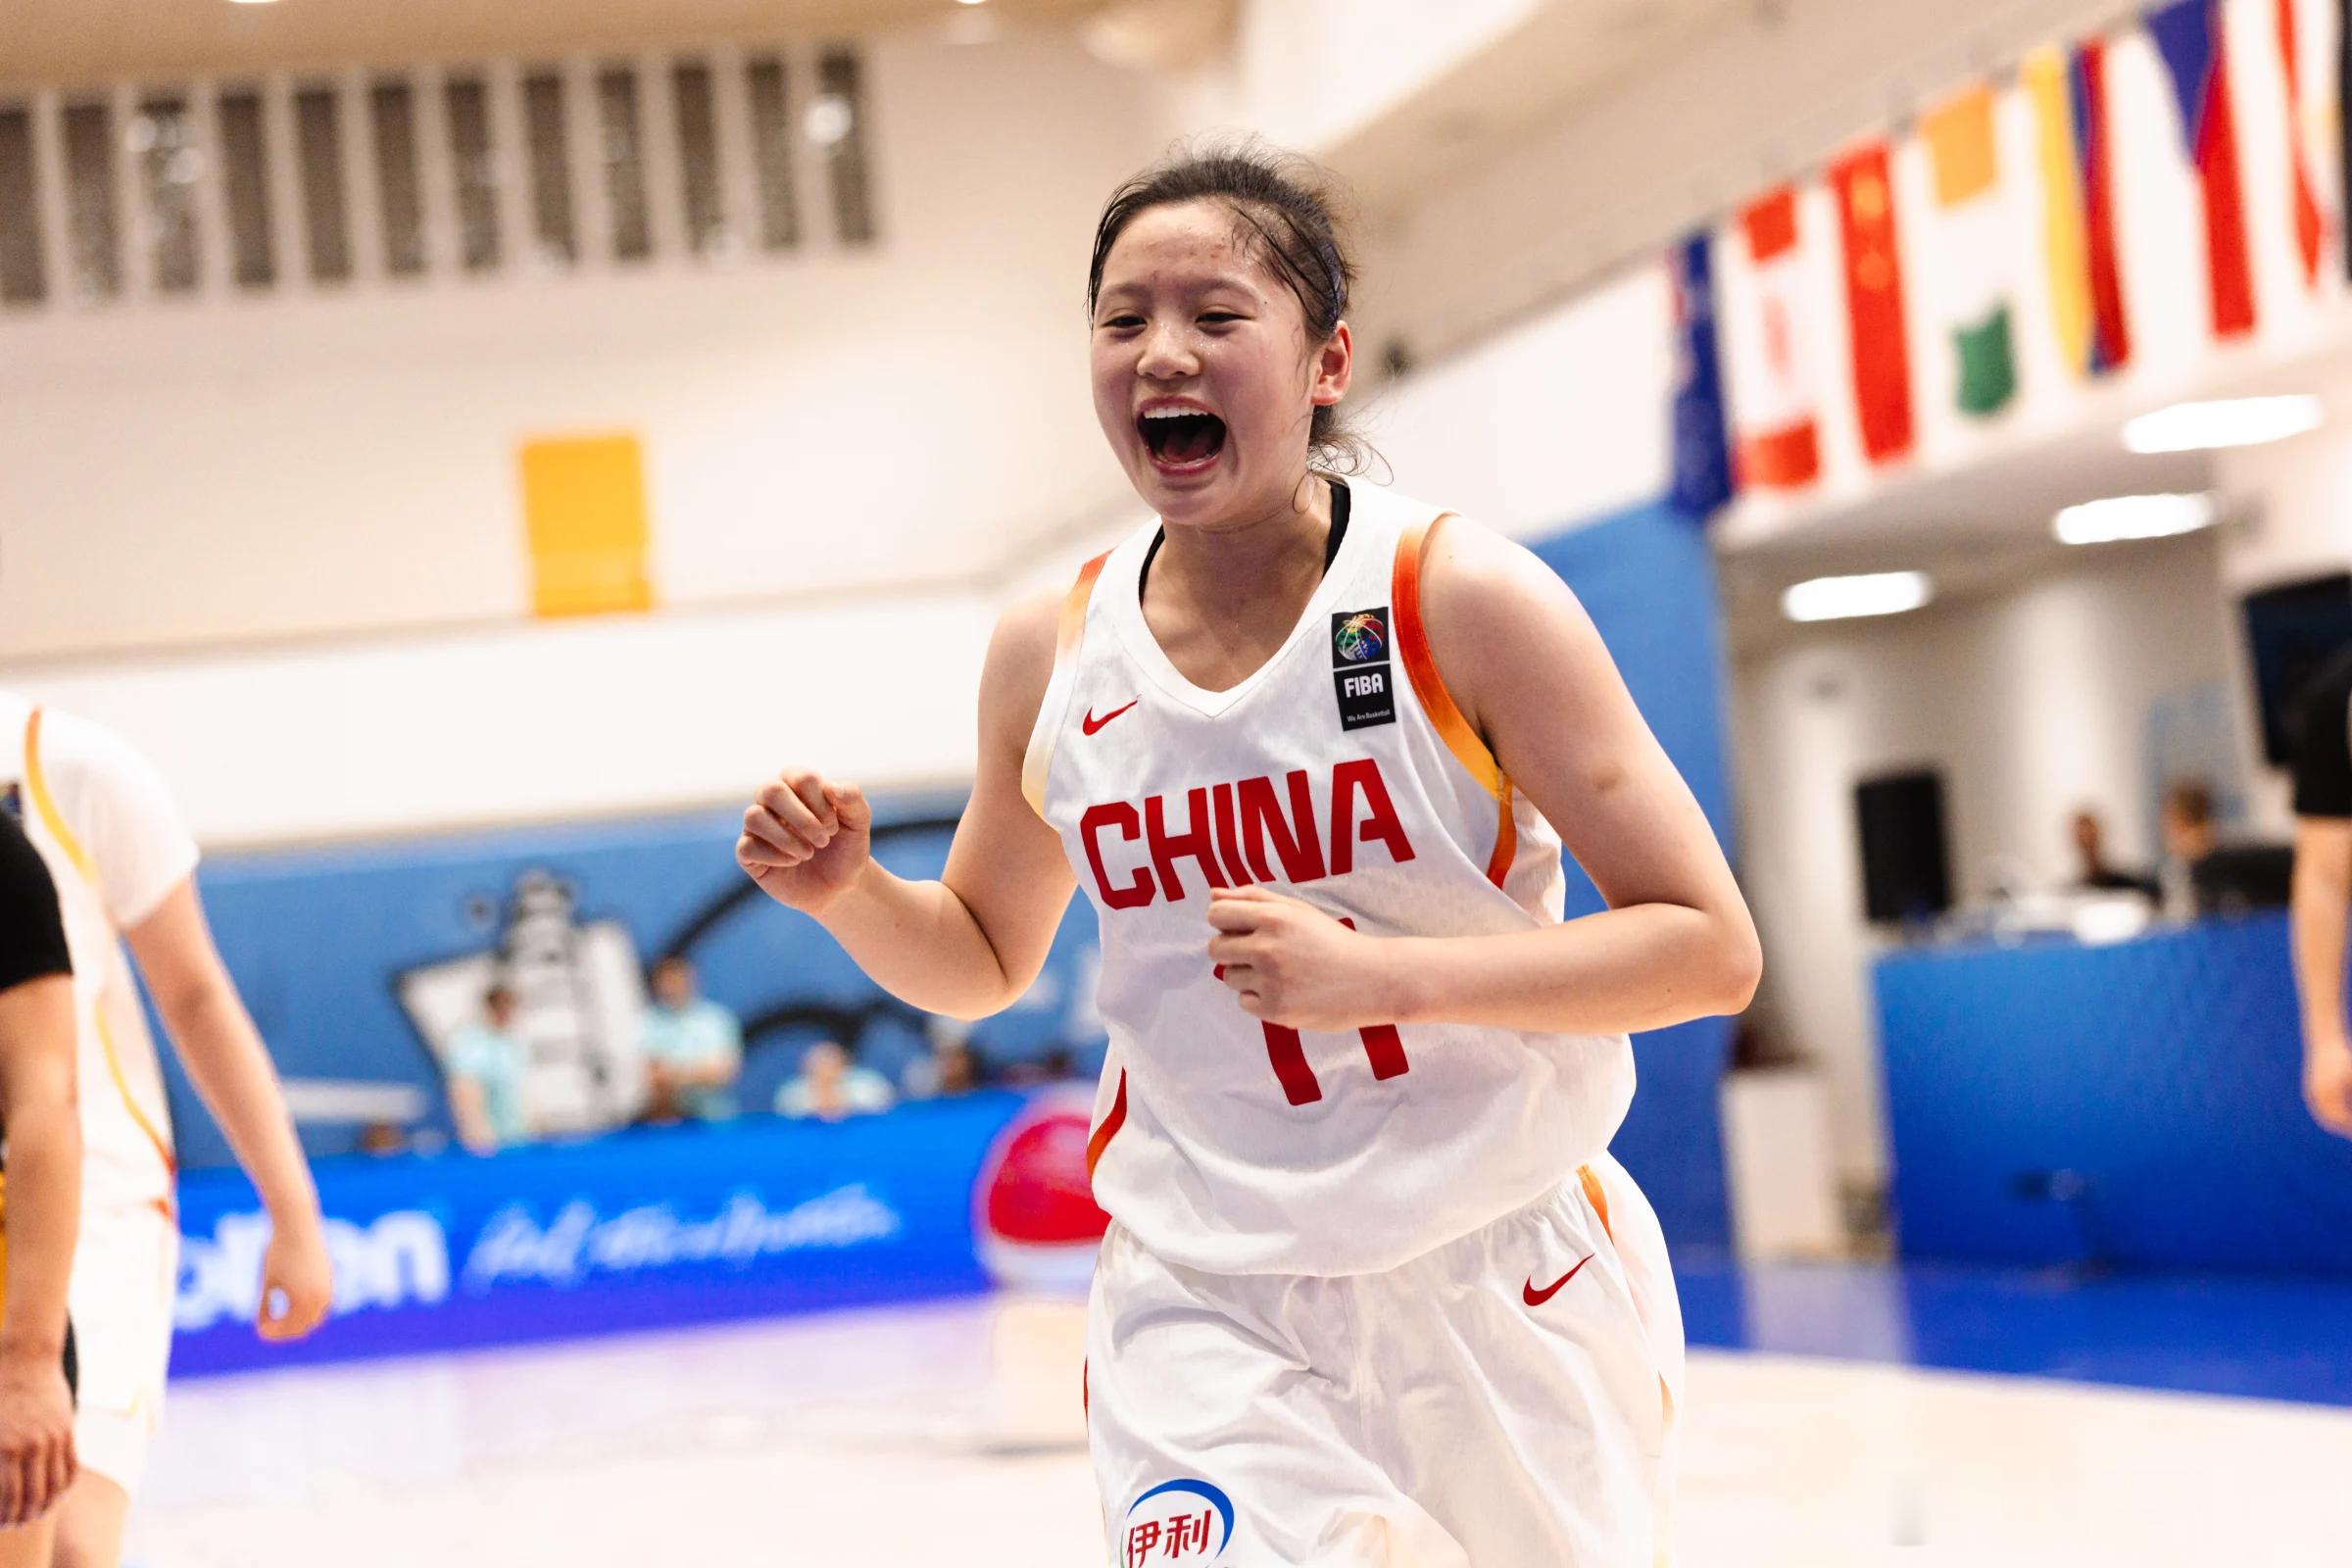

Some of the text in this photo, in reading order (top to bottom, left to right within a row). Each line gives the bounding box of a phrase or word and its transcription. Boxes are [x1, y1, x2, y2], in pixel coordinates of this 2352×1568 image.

[1344, 673, 1385, 698] FIBA
[1080, 759, 1415, 910] CHINA
[1127, 1509, 1211, 1568] 伊利
